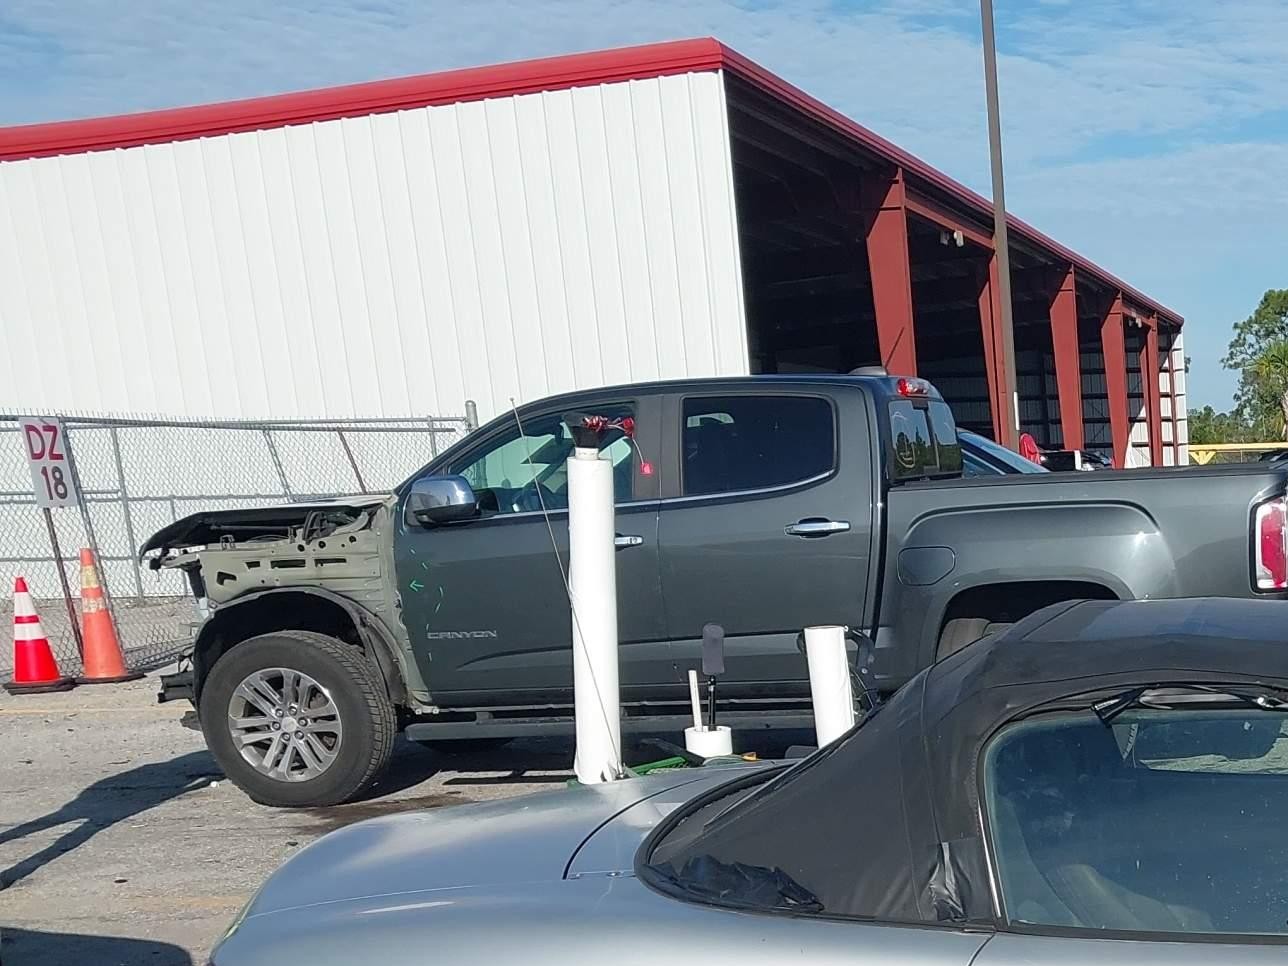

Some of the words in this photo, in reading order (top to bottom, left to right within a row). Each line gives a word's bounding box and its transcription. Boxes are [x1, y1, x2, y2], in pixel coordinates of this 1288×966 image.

[25, 425, 64, 460] DZ
[40, 466, 68, 500] 18
[427, 630, 497, 640] CANYON
